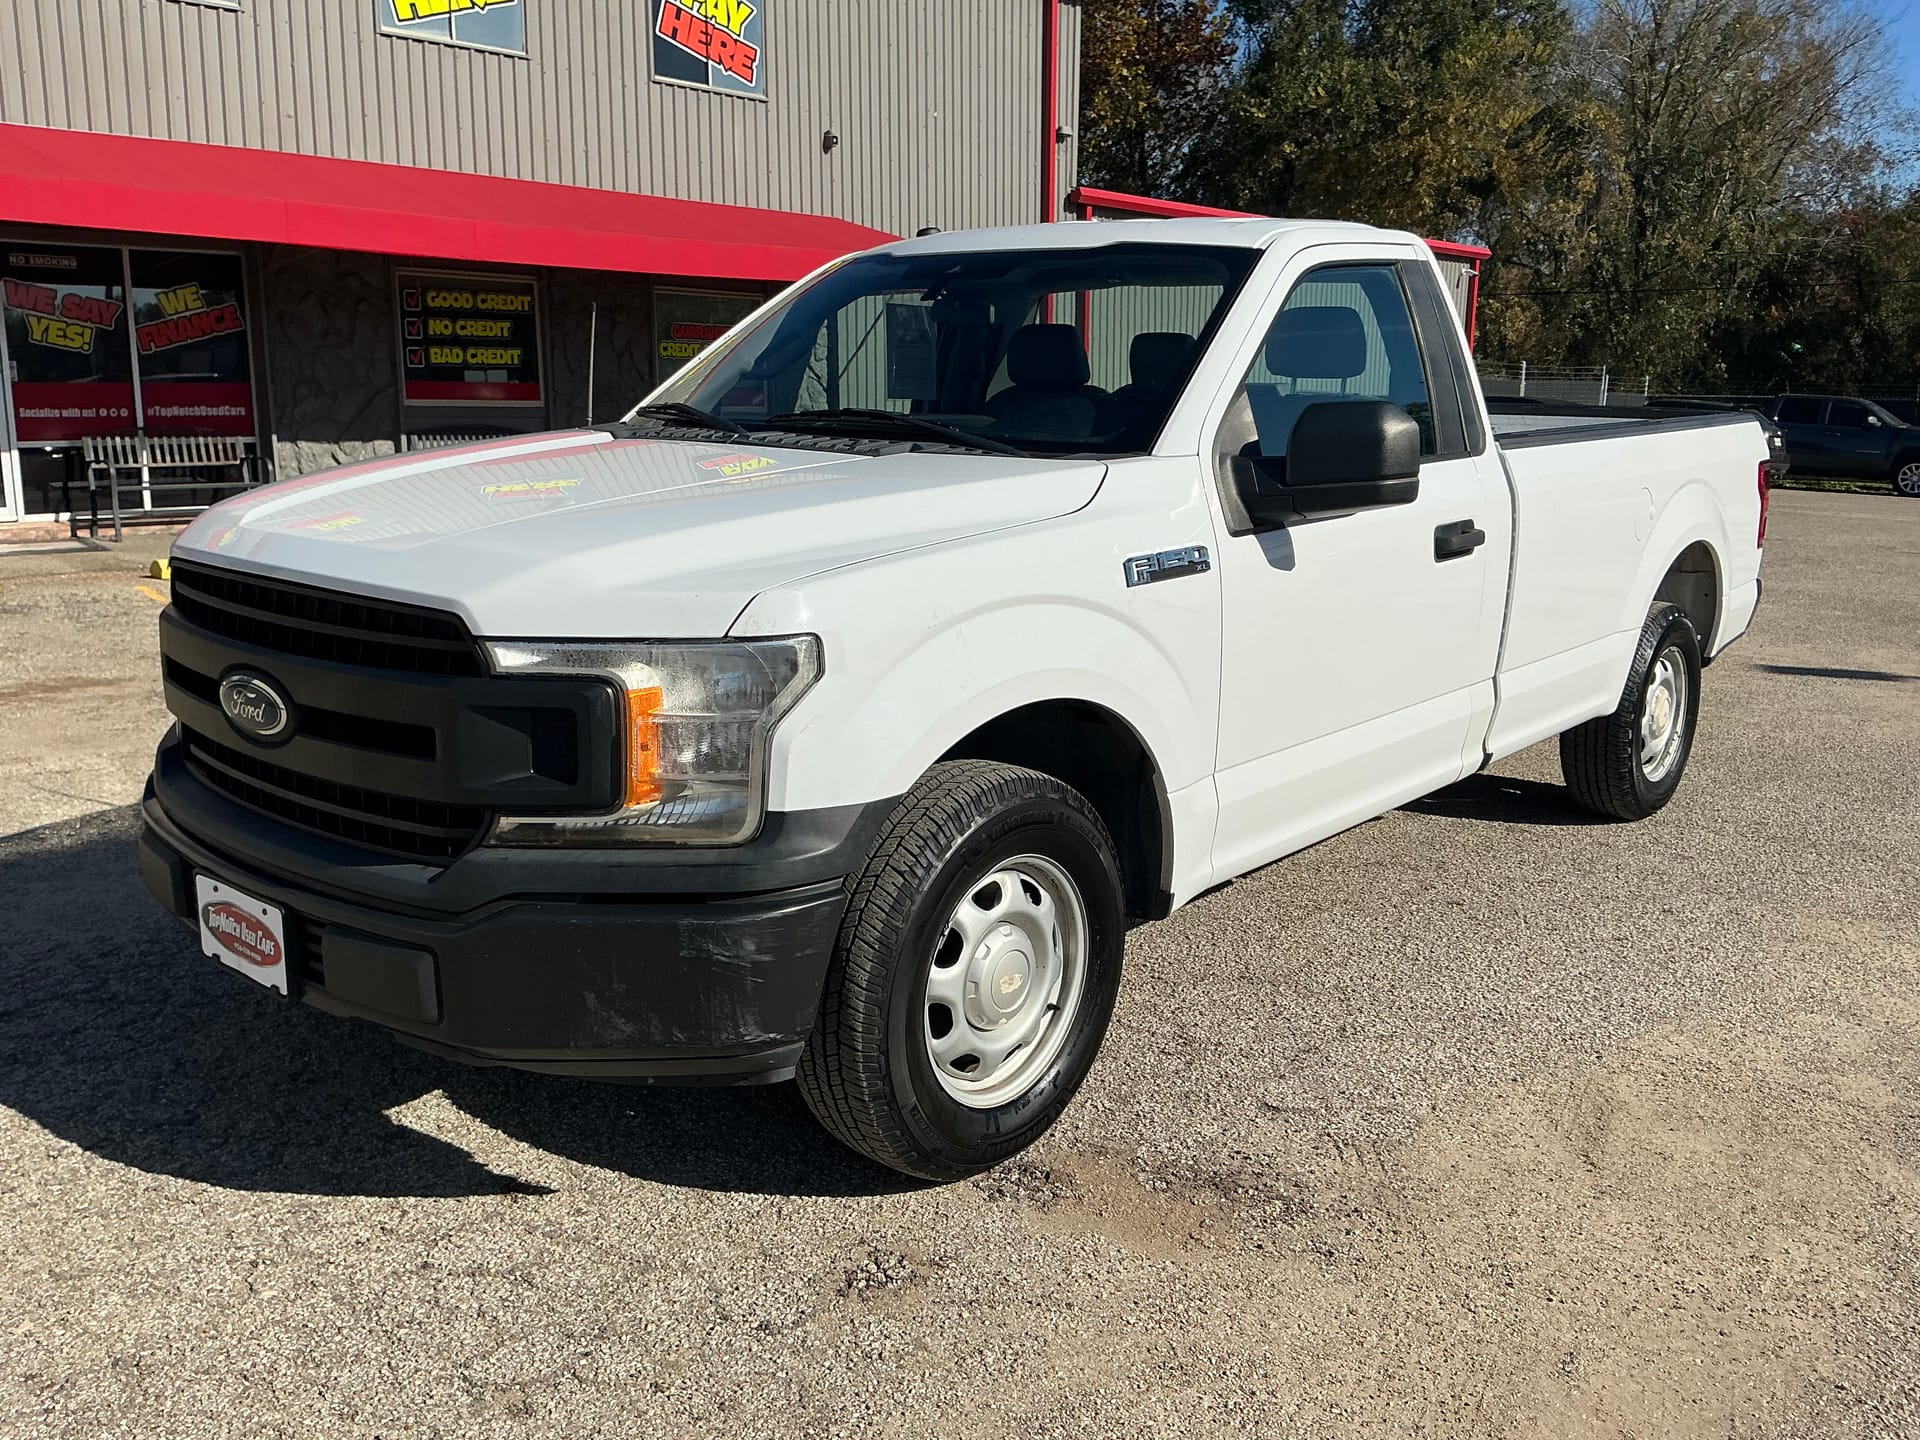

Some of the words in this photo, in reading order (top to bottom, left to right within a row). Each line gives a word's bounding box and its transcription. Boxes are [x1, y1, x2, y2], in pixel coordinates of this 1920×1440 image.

[659, 1, 758, 83] HERE
[9, 255, 25, 264] NO
[29, 256, 78, 267] SMOKING
[3, 279, 57, 316] WE
[61, 293, 121, 327] SAY
[156, 284, 203, 316] WE
[427, 291, 473, 308] GOOD
[477, 294, 532, 311] CREDIT
[25, 313, 93, 352] YES!
[136, 304, 242, 352] FINANCE
[428, 319, 452, 336] NO
[456, 320, 511, 337] CREDIT
[430, 348, 463, 364] BAD
[467, 349, 521, 365] CREDIT
[61, 407, 81, 417] with
[231, 688, 265, 722] Ford
